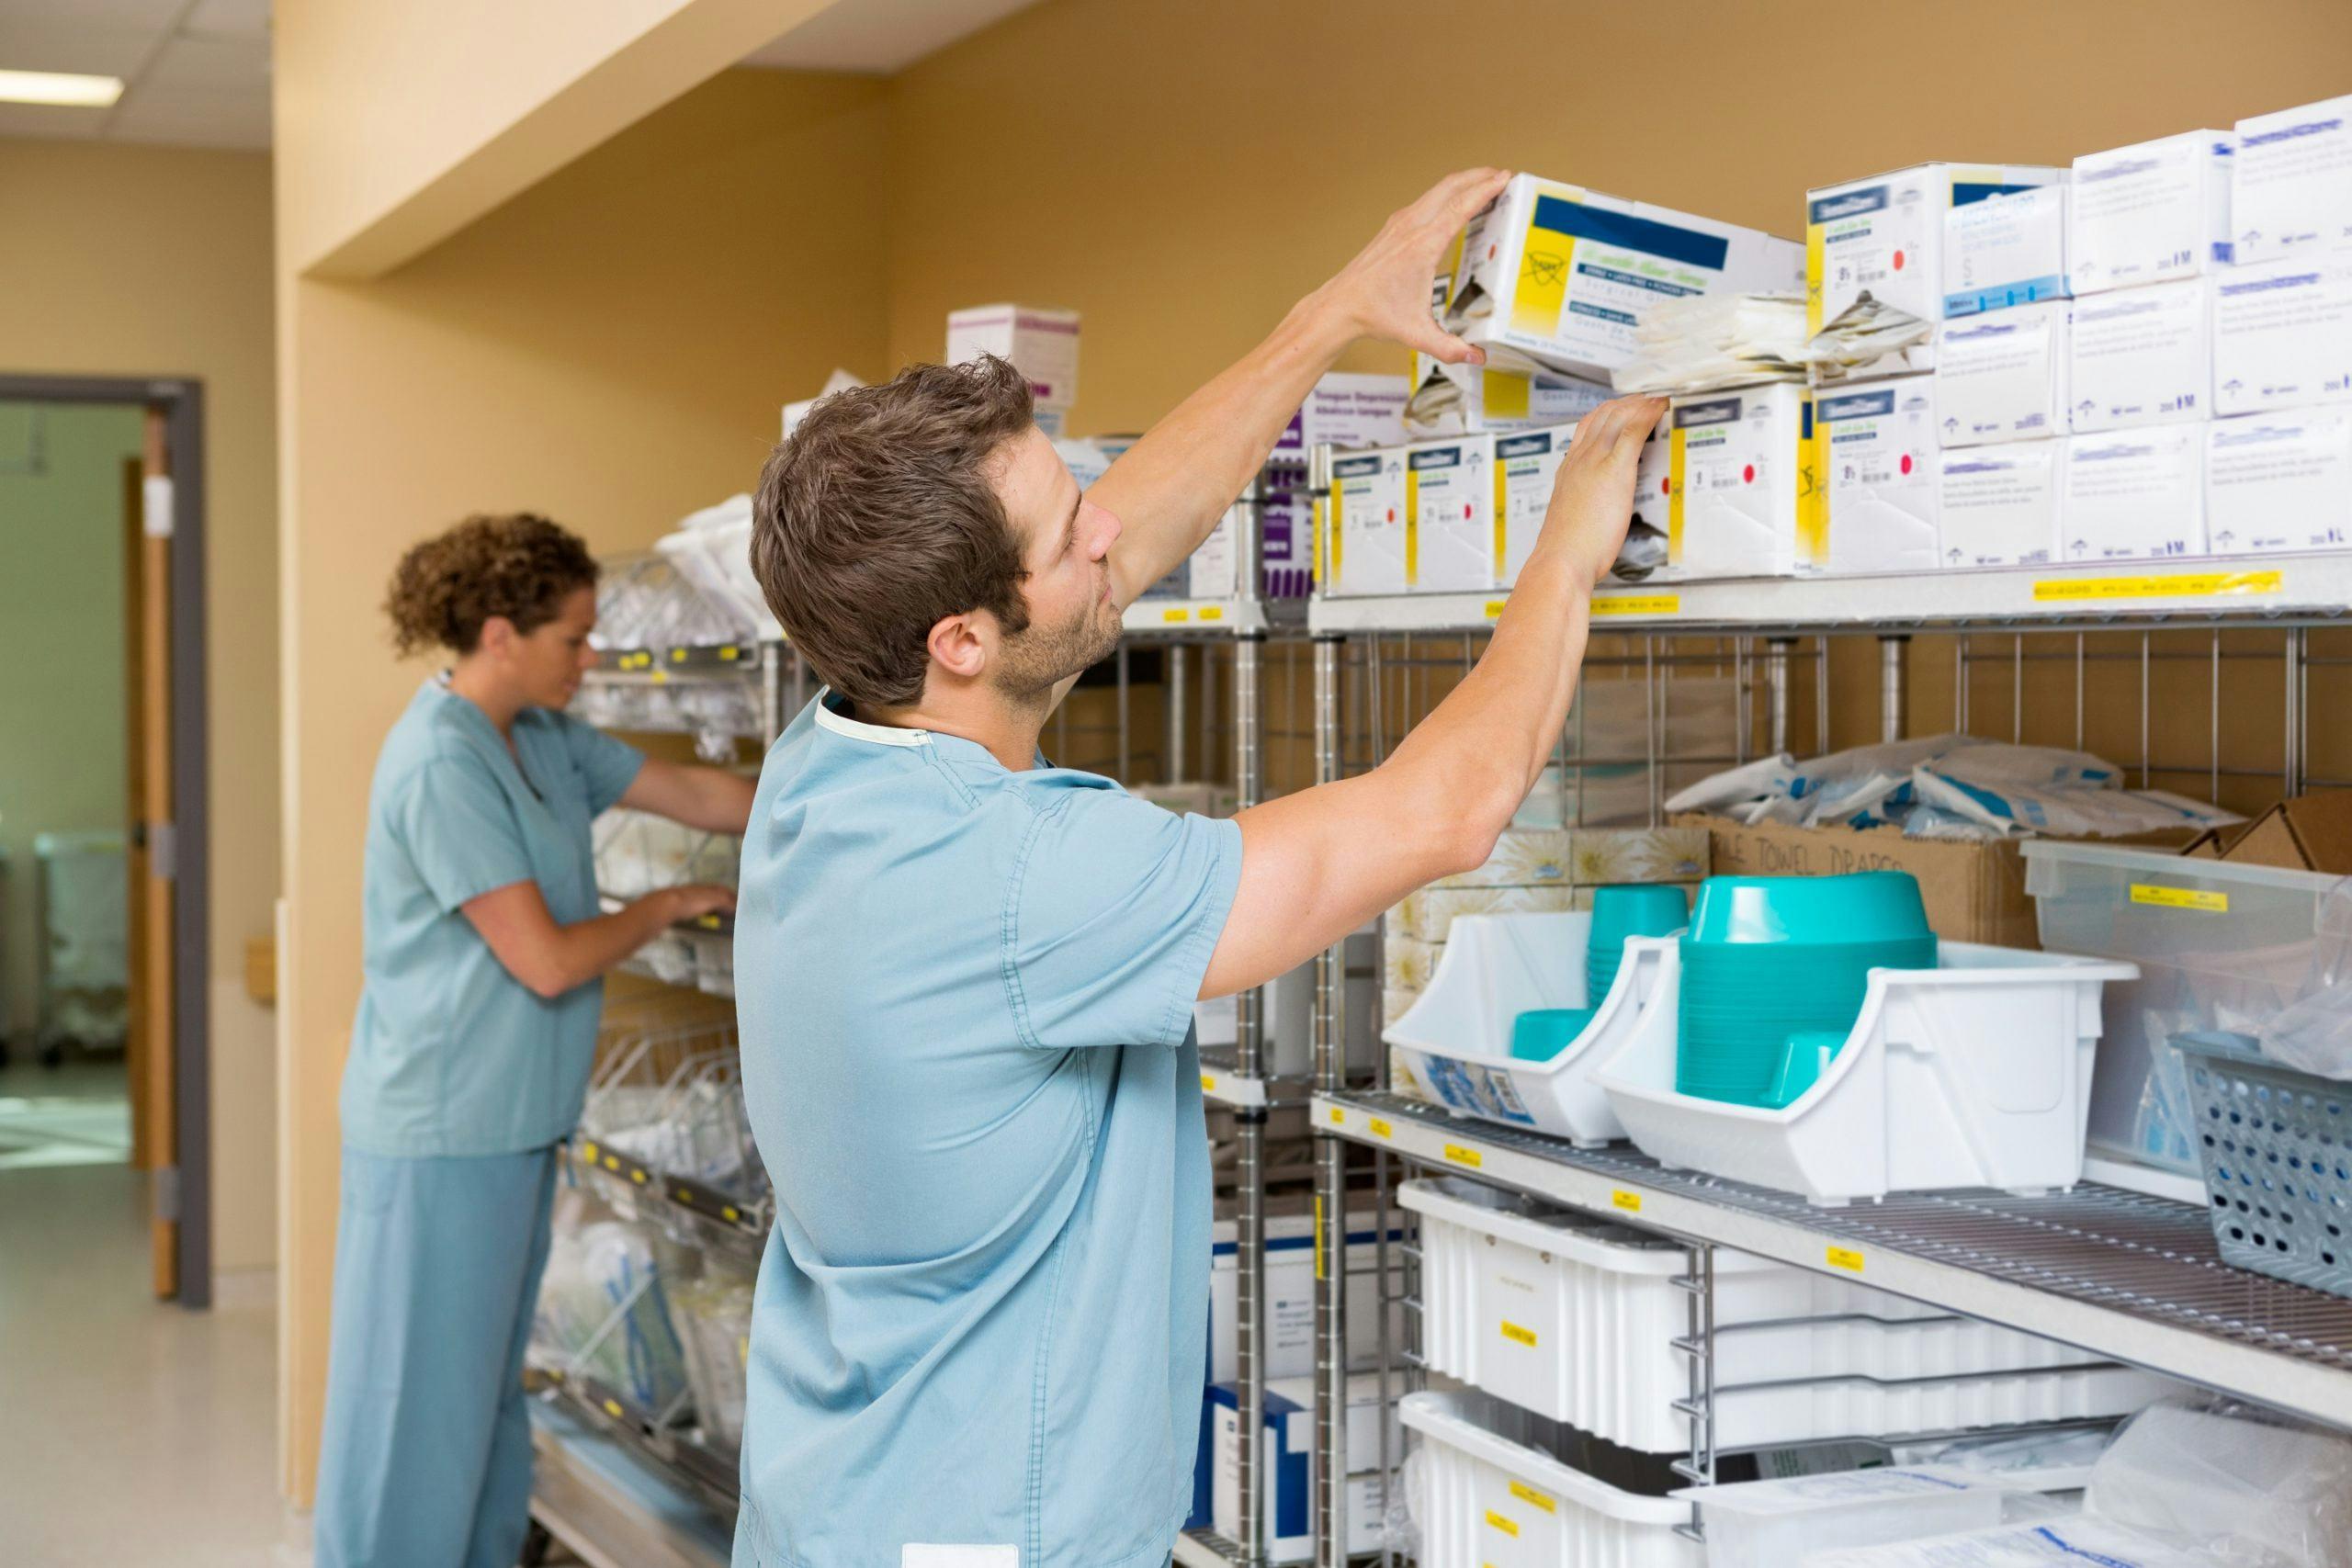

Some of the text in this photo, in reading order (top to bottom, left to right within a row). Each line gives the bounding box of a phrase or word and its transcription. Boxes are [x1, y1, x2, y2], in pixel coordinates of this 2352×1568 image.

[2181, 250, 2191, 264] M
[2185, 394, 2195, 407] M
[2175, 539, 2186, 553] M
[1756, 838, 1815, 875] TOWEL
[1829, 844, 1903, 874] DRAP
